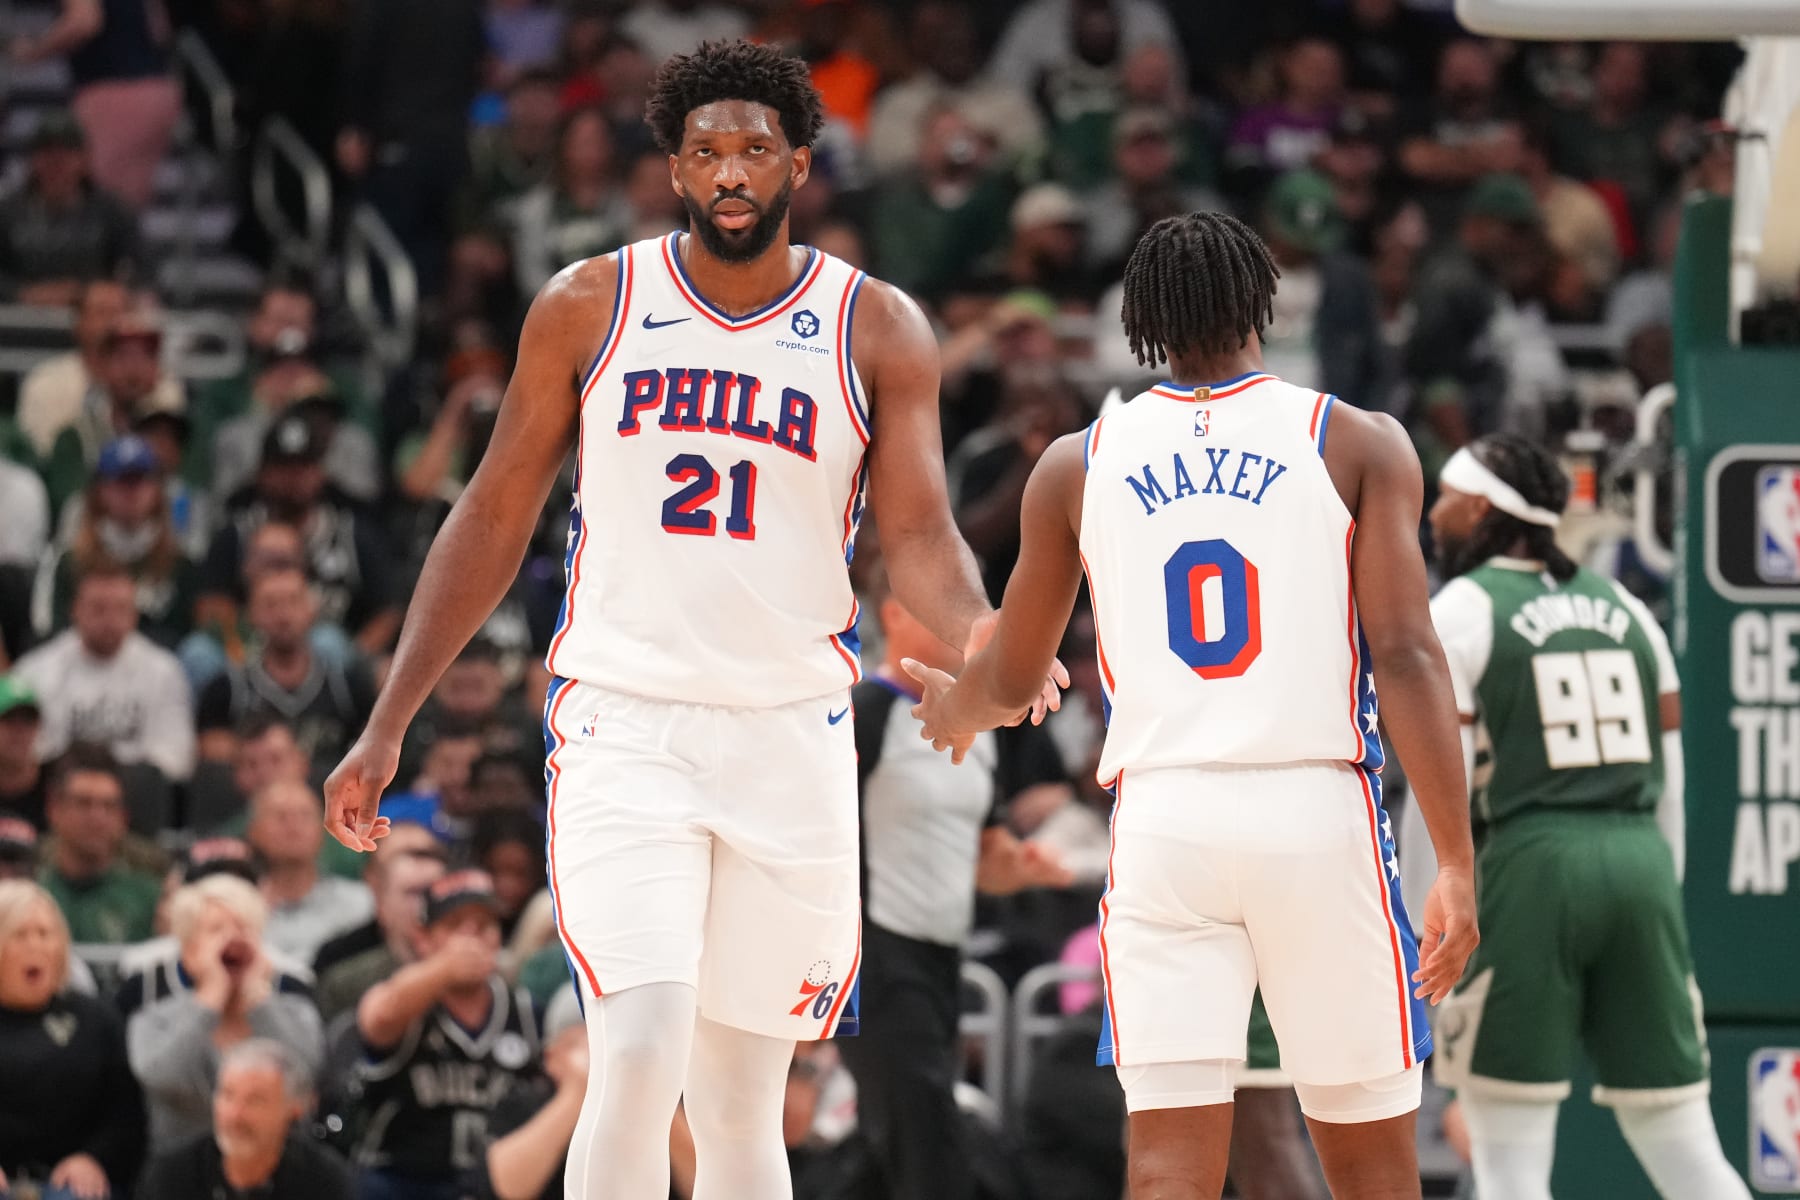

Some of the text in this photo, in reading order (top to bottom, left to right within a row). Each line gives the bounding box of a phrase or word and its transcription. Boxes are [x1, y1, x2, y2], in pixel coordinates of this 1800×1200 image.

[775, 339, 829, 355] crypto.com
[617, 367, 818, 463] PHILA
[661, 453, 757, 541] 21
[1125, 448, 1287, 516] MAXEY
[1164, 538, 1262, 680] 0
[1531, 649, 1652, 769] 99
[789, 978, 839, 1020] 76
